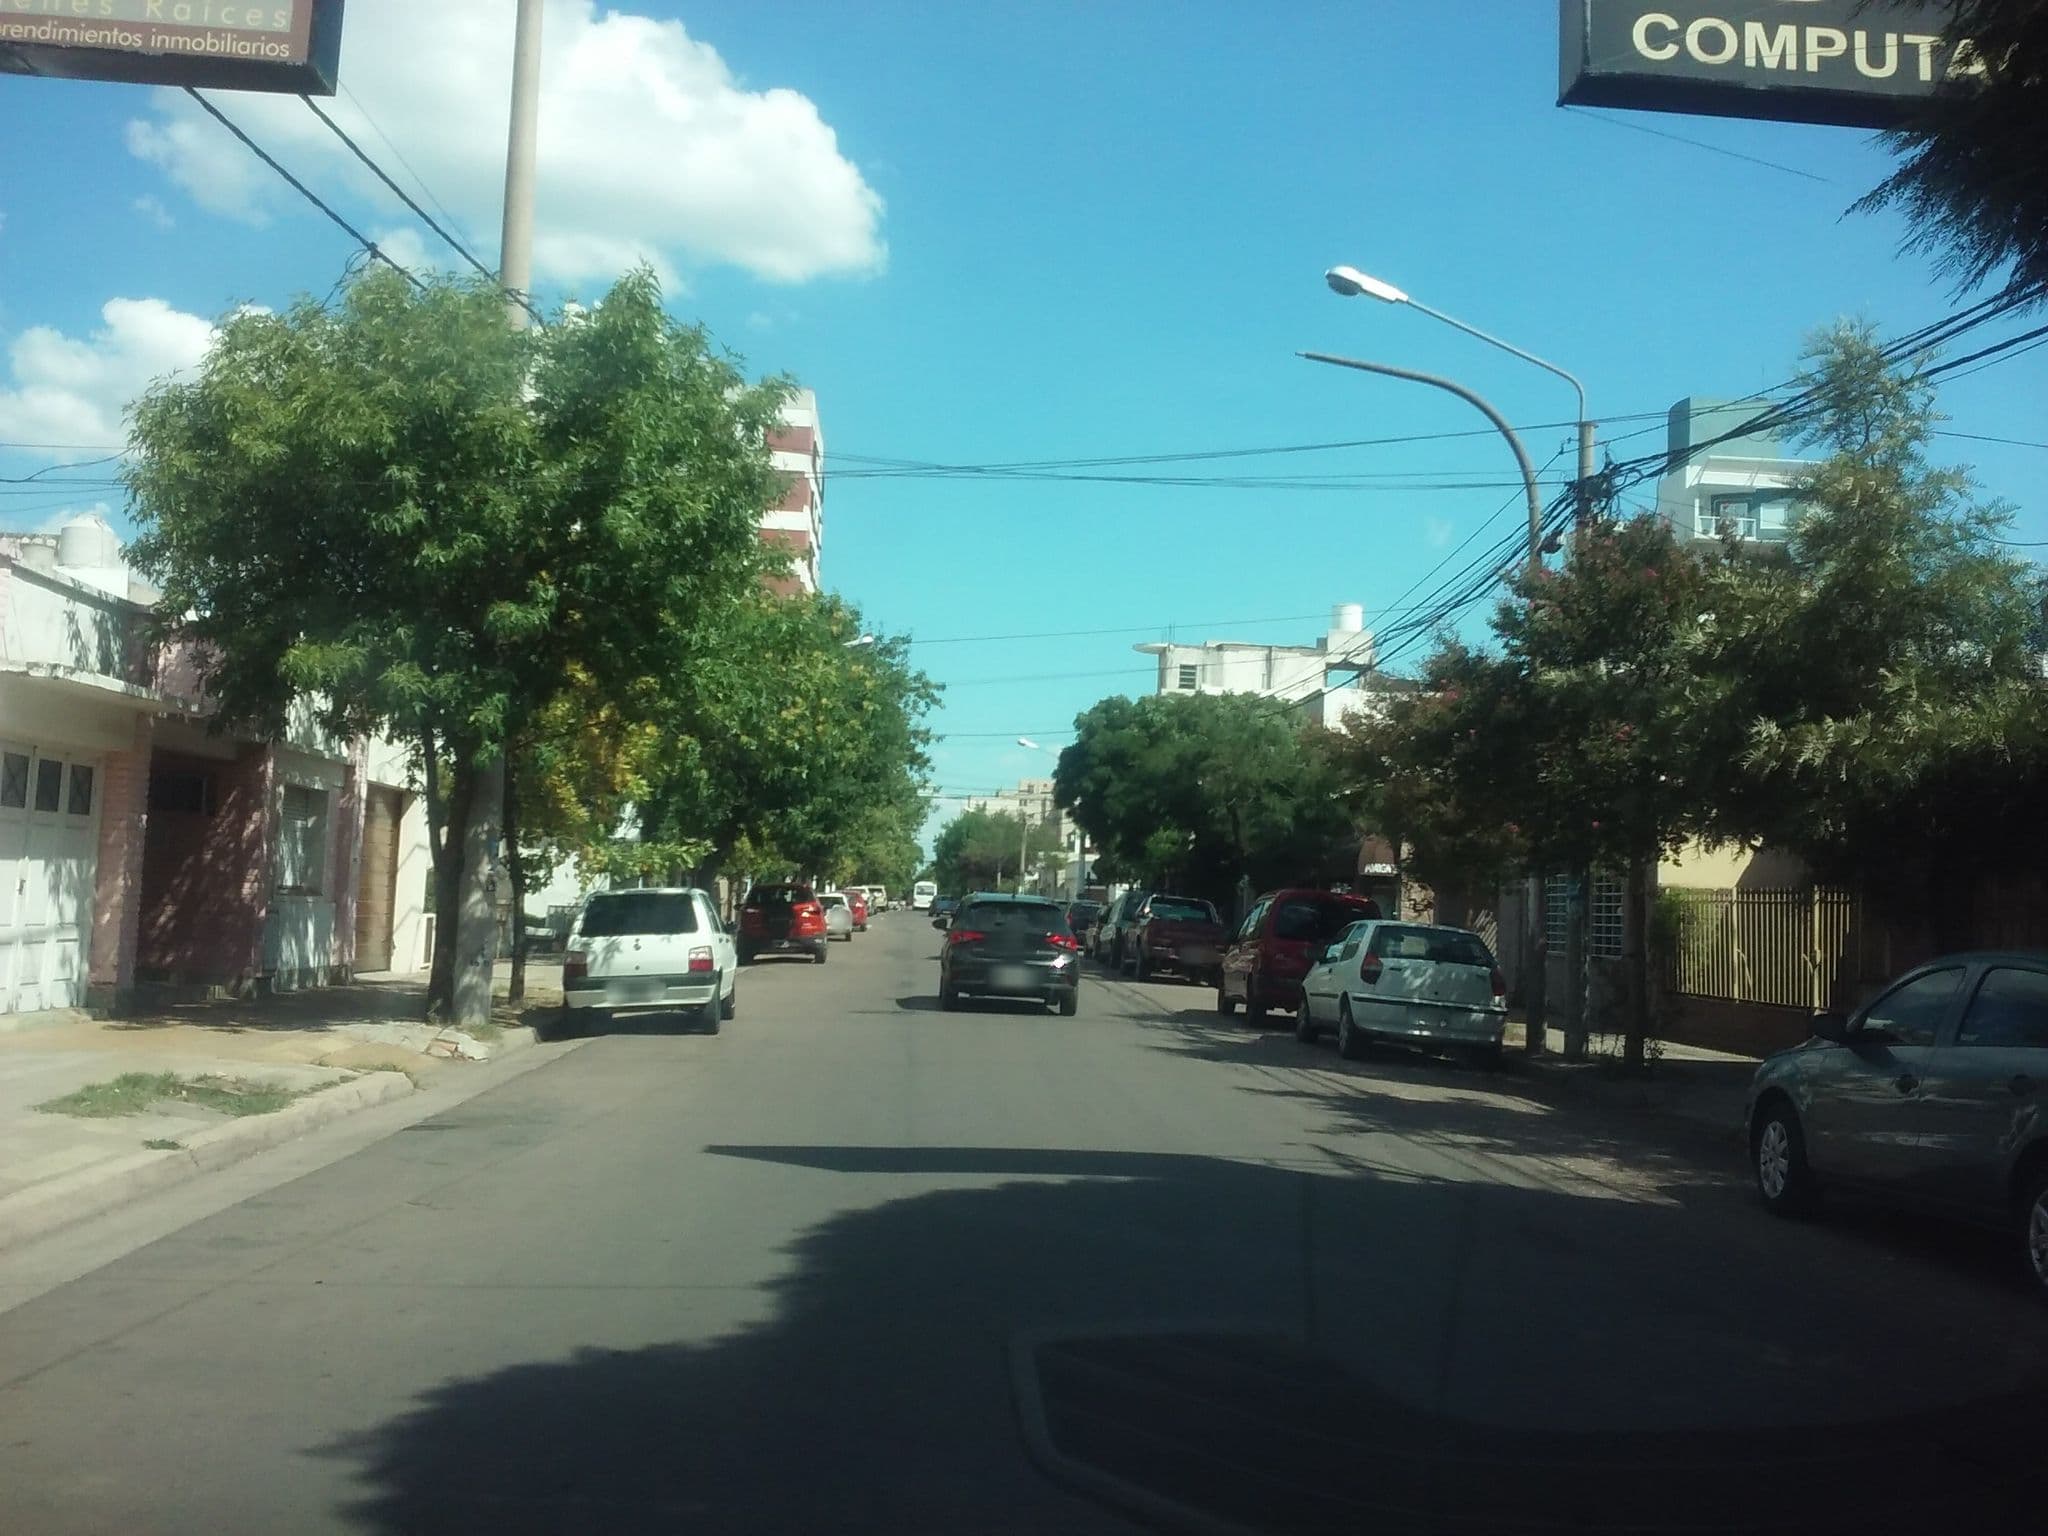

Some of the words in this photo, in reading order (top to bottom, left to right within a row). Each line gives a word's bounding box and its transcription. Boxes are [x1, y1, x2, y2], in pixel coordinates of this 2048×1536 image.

[0, 0, 113, 15] enes
[0, 20, 143, 47] rendimientos
[150, 27, 290, 57] inmobiliarios
[1632, 13, 1998, 86] COMPUTA
